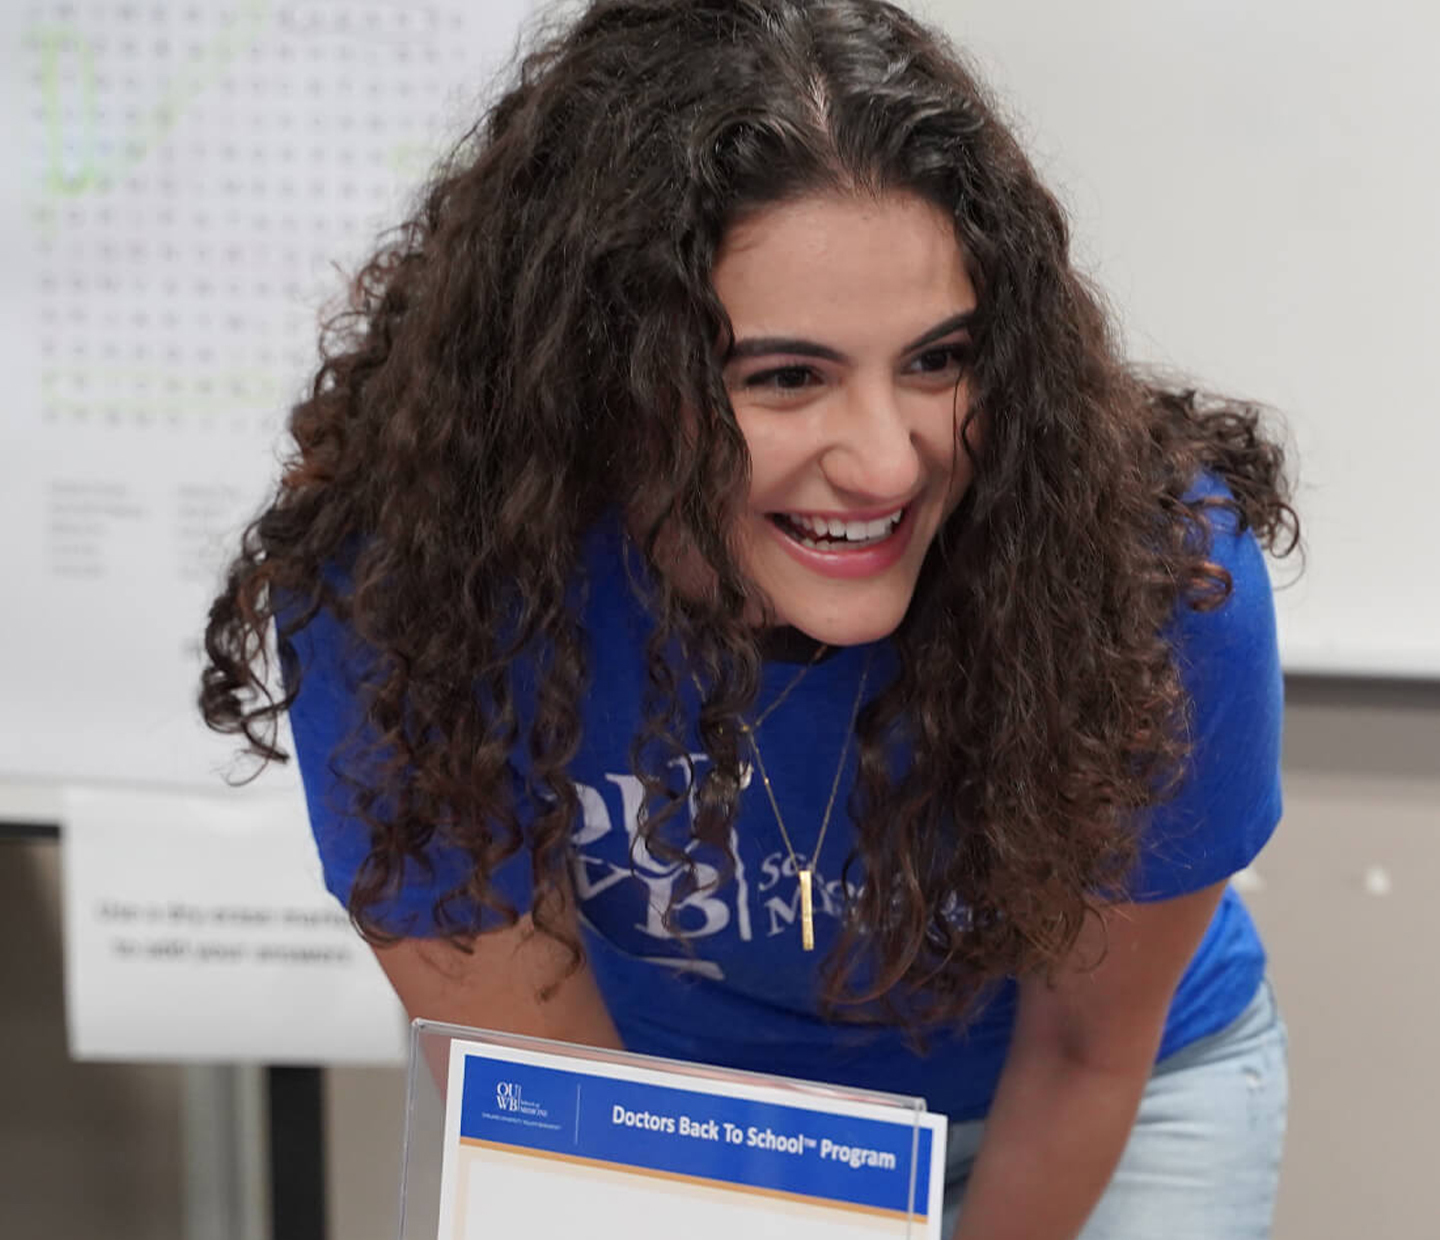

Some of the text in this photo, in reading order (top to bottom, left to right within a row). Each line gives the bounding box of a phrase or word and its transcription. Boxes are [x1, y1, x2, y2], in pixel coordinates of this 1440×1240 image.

[496, 1081, 519, 1097] OU
[496, 1095, 519, 1112] WB
[612, 1104, 675, 1133] Doctors
[679, 1115, 719, 1142] Back
[722, 1123, 743, 1145] To
[820, 1138, 897, 1170] Program
